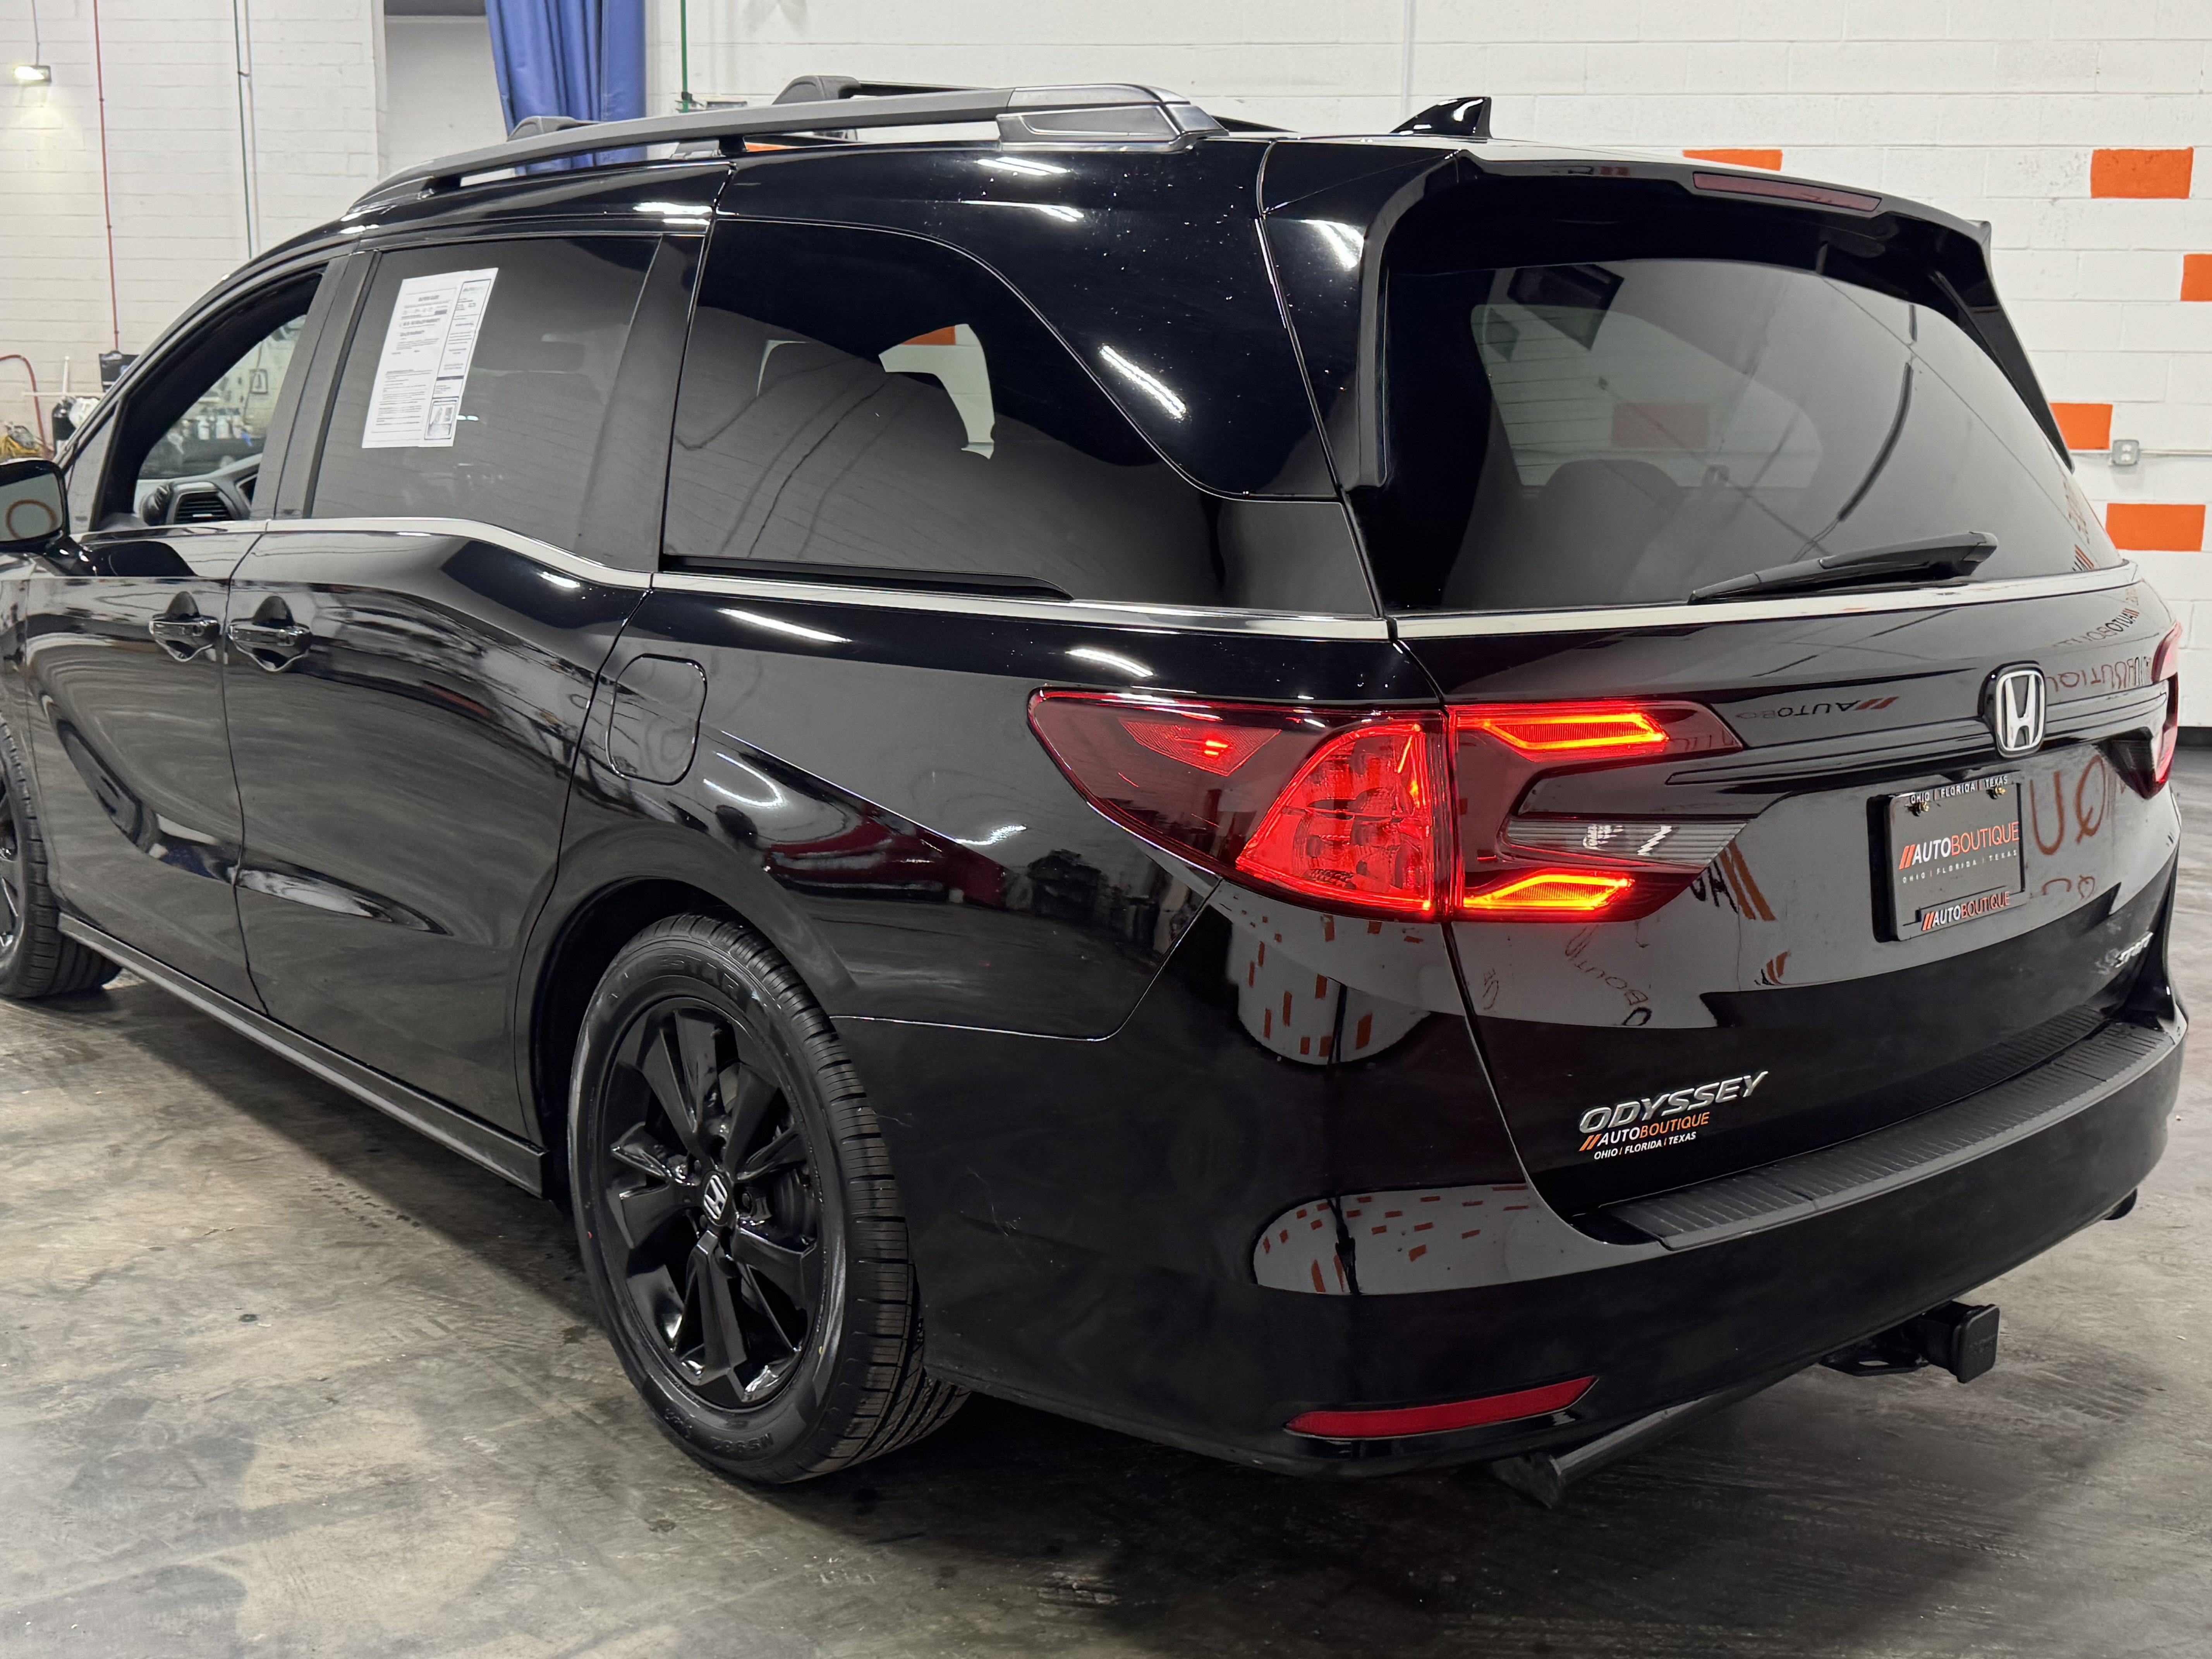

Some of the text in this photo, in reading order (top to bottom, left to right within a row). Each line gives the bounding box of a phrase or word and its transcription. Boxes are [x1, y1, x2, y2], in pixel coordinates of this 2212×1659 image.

[1910, 775, 2008, 804] OHIO FLORIDA TEXAS
[1902, 849, 2017, 884] OHIO FLORIDA TEXAS
[1579, 1071, 1768, 1133] ODYSSEY
[1594, 1131, 1697, 1160] OHIO FLORIDA TEXAS
